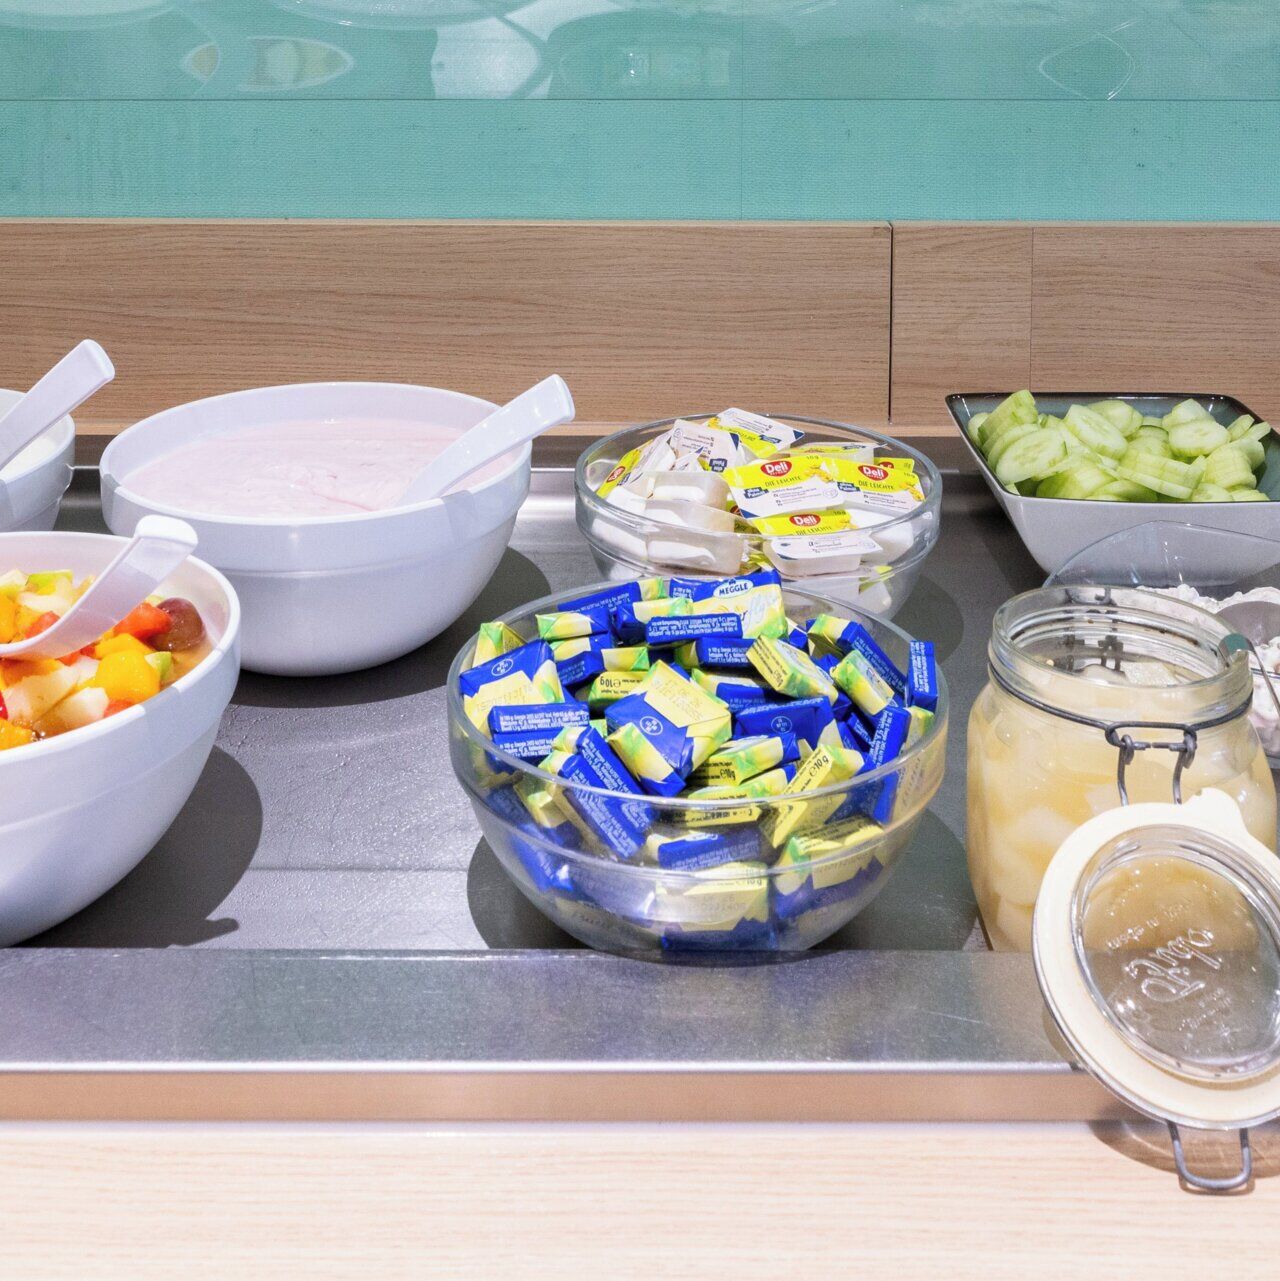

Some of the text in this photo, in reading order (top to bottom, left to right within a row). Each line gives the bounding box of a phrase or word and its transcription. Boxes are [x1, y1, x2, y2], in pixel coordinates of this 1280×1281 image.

[764, 461, 789, 474] Deli
[863, 466, 885, 478] Deli
[793, 515, 817, 526] Deli
[719, 582, 748, 596] MEGGLE
